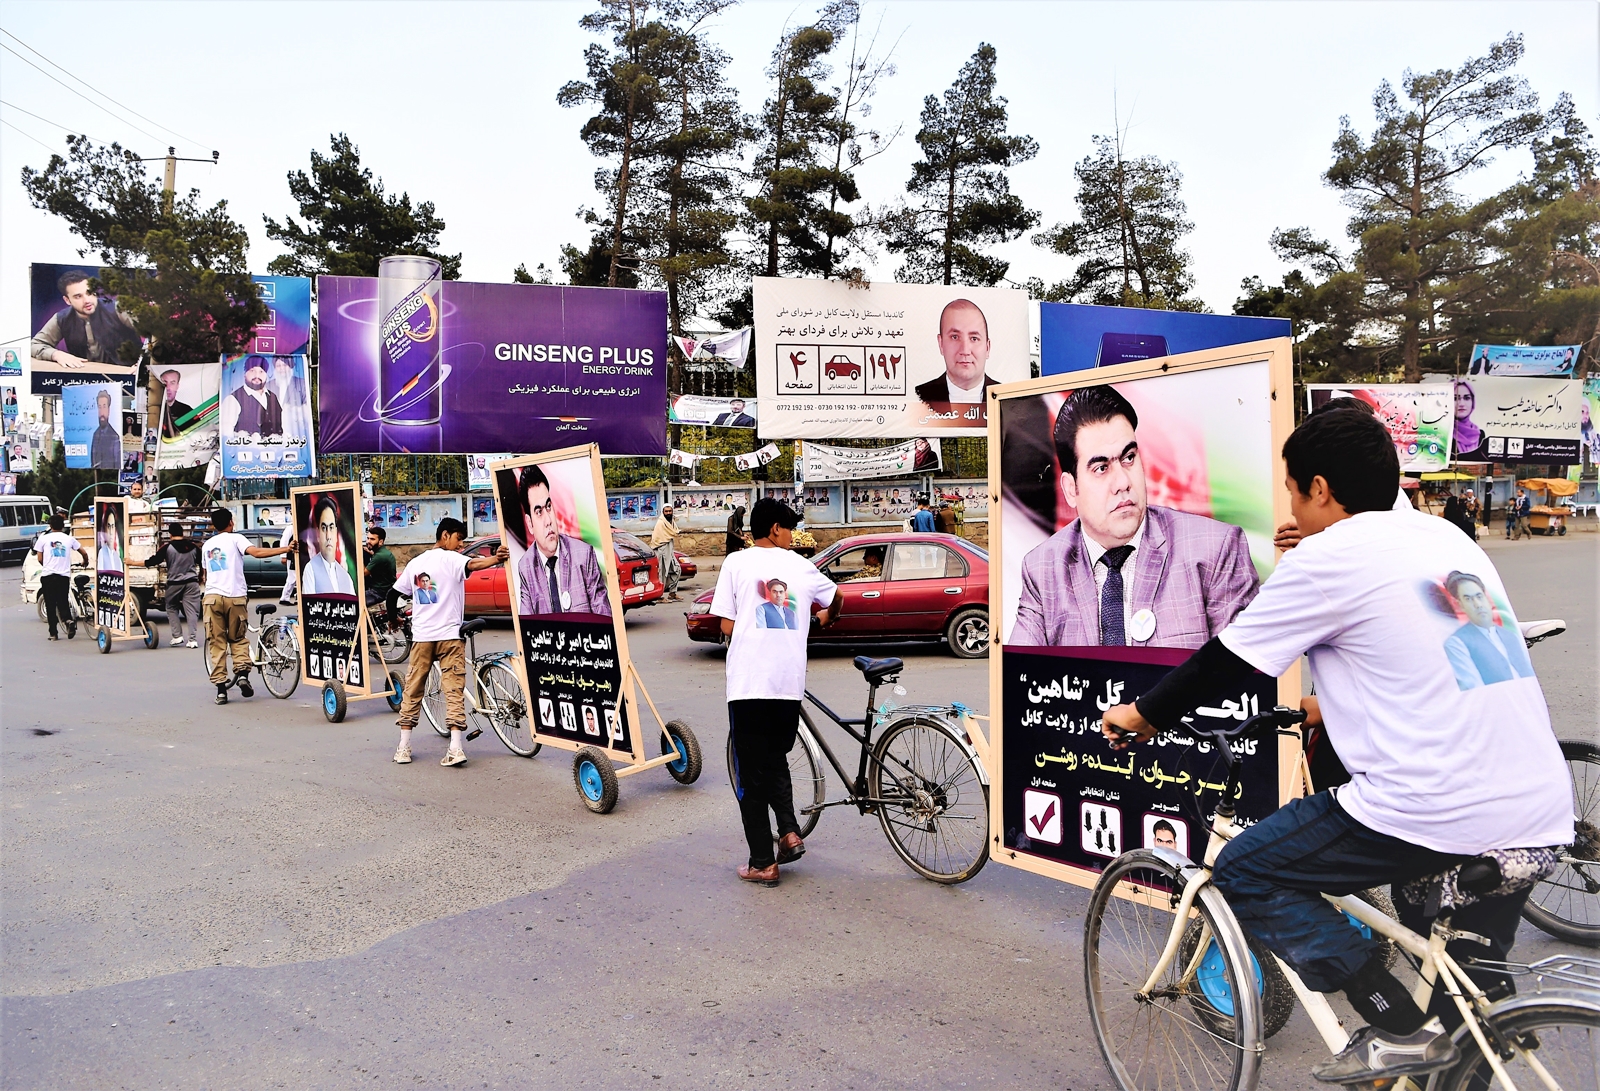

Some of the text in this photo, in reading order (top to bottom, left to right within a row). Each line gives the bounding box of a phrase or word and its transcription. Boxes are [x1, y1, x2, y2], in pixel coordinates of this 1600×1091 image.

[382, 296, 423, 338] GINSENG
[776, 307, 788, 318] ملی
[790, 308, 813, 318] شورای
[824, 308, 839, 319] کابل
[840, 309, 859, 318] ولایت
[861, 310, 881, 320] مستقل
[385, 322, 411, 350] PLUS
[777, 326, 796, 336] بهتر
[799, 324, 825, 337] فردای
[829, 325, 848, 338] برای
[851, 326, 873, 338] تلاش
[885, 328, 904, 338] تعهد
[494, 343, 654, 365] GINSENG PLUS
[583, 365, 653, 376] ENERGY DRINK
[790, 351, 807, 380] ۴
[870, 353, 901, 380] ۱۹۲
[508, 384, 640, 396] انرژی طبیعی برای عملکرد فیزیکی
[785, 380, 813, 389] صفحه
[918, 408, 959, 425] عصمتی
[963, 406, 979, 420] الله
[226, 437, 252, 445] خالصه
[556, 631, 565, 650] گل
[569, 633, 582, 651] امیر
[583, 633, 611, 653] الحاج
[1096, 680, 1124, 711] گل
[1021, 709, 1043, 727] کابل
[1046, 714, 1074, 734] ولایت
[1078, 719, 1087, 735] از
[1035, 746, 1078, 771] روشن
[1031, 776, 1056, 788] صفحه اول
[1080, 787, 1120, 801] نشان انتخاباتی
[1150, 801, 1180, 812] تصویر
